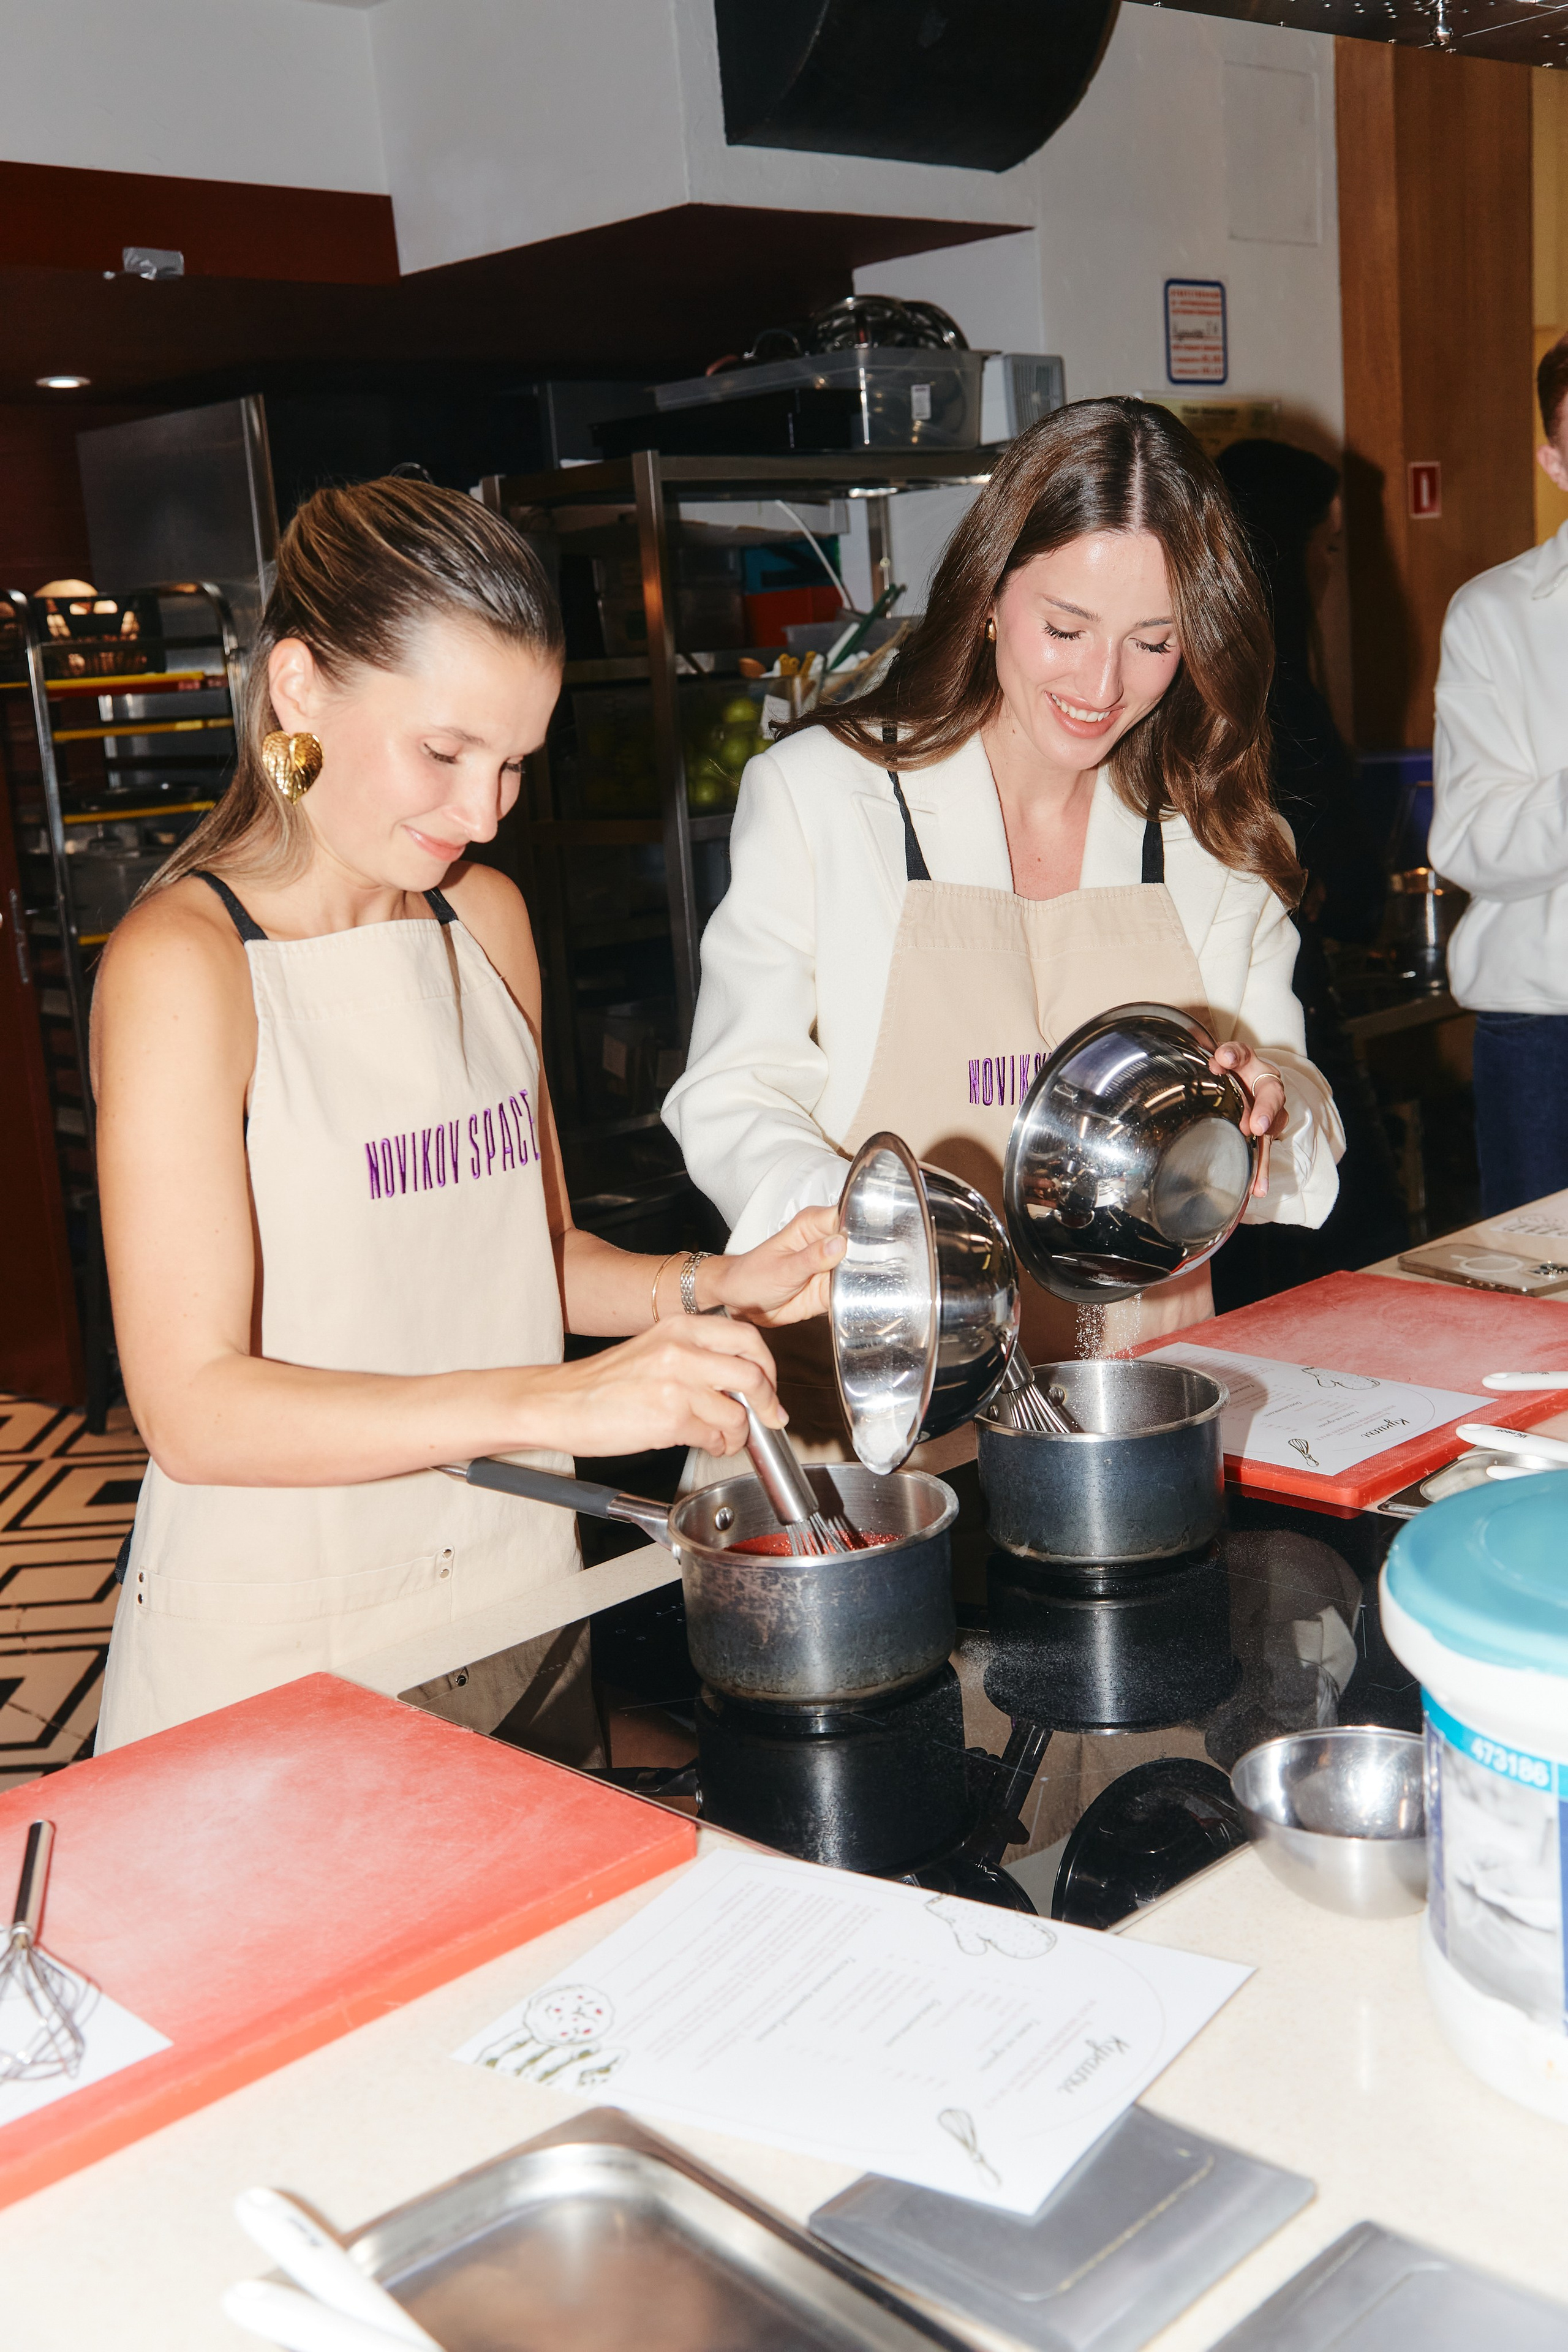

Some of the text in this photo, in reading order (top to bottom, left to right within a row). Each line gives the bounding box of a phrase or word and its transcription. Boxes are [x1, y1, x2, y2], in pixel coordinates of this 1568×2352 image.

[968, 1052, 1052, 1106] NOVIK
[364, 1120, 459, 1200] NOVIKOV
[1360, 1418, 1410, 1438] Кукисы
